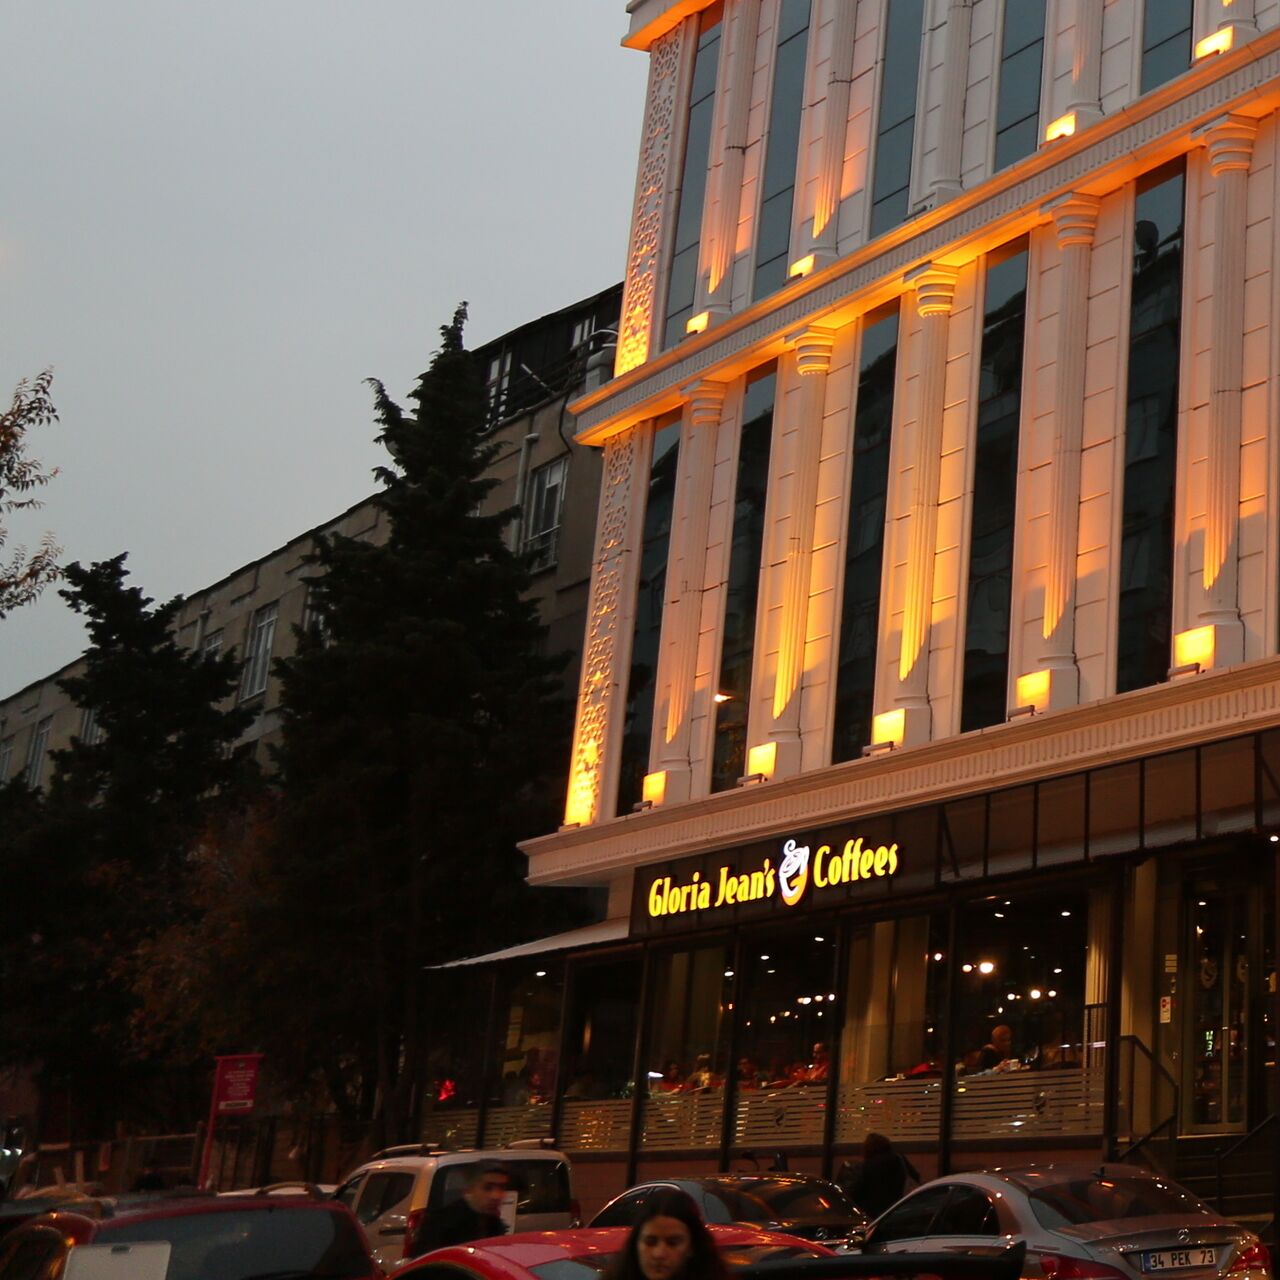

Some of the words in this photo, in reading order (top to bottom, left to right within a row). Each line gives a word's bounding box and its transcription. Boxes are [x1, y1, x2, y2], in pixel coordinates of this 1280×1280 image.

[648, 870, 711, 918] Gloria
[714, 858, 775, 908] Jean's
[812, 836, 899, 888] Coffees
[1151, 1254, 1164, 1268] 34
[1171, 1252, 1191, 1266] PEK
[1201, 1250, 1214, 1264] 73
